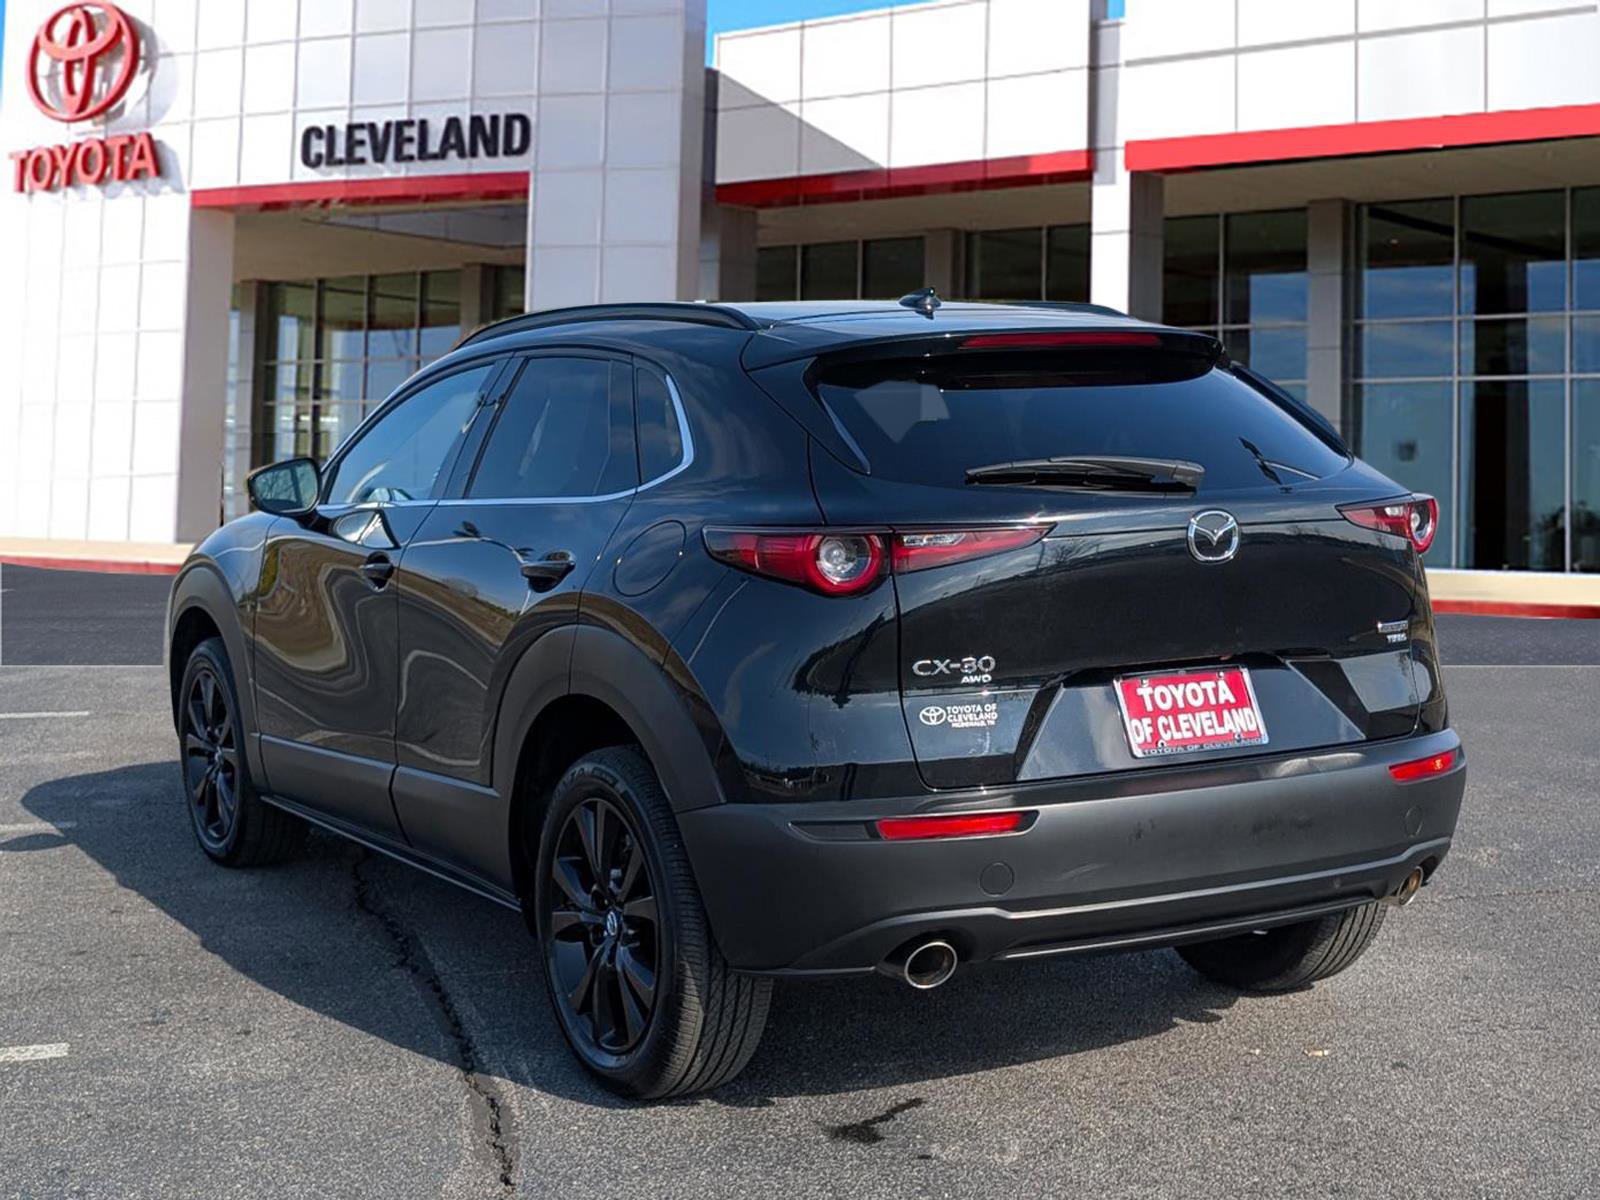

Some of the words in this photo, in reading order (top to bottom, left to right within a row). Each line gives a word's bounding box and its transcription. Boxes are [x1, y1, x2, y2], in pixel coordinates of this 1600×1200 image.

[301, 113, 531, 169] CLEVELAND
[8, 132, 161, 193] TOYOTA
[912, 656, 996, 676] CX-30
[961, 674, 992, 684] AWD
[1137, 680, 1236, 712] TOYOTA
[946, 704, 982, 714] TOYOTA
[984, 703, 997, 712] OF
[947, 712, 998, 723] CLEVELAND
[1131, 718, 1153, 744] OF
[1157, 707, 1257, 741] CLEVELAND
[1143, 745, 1185, 756] TOYOTA
